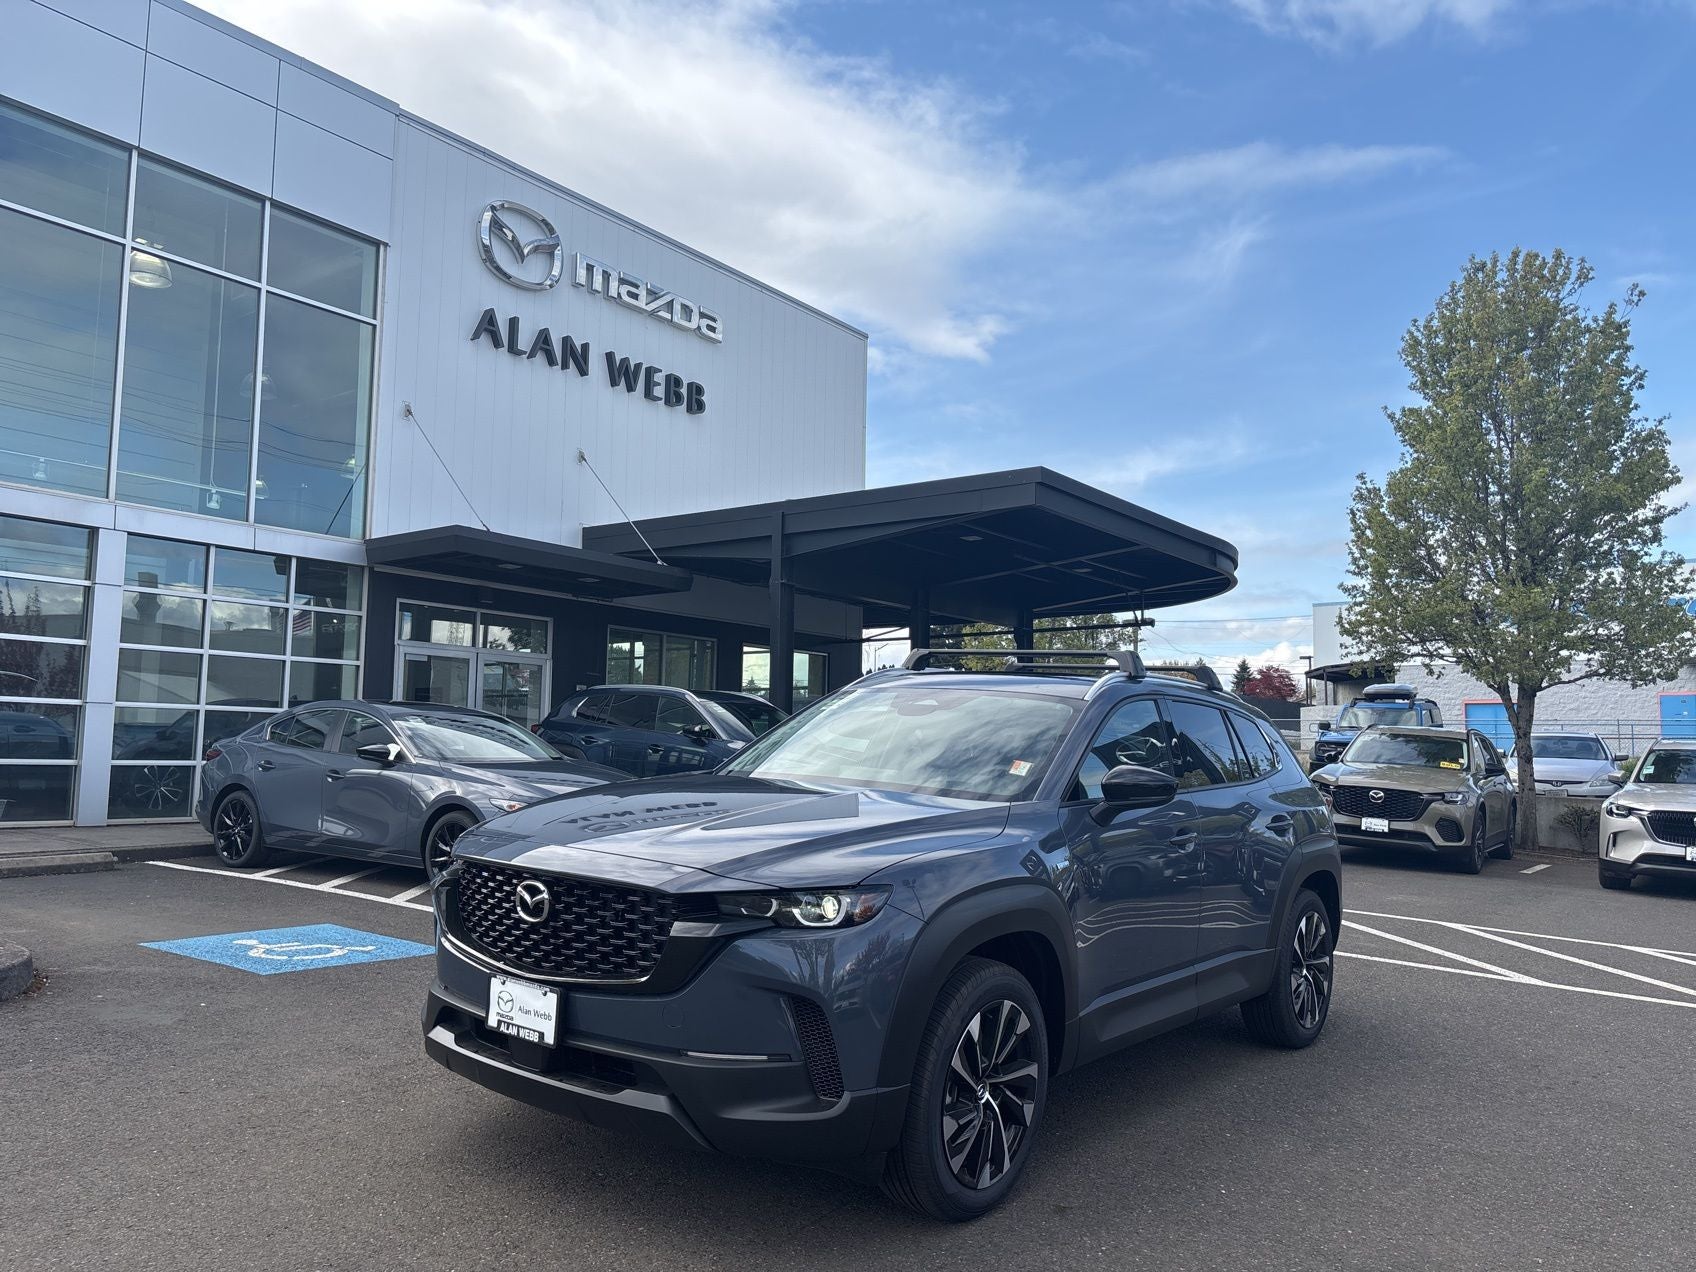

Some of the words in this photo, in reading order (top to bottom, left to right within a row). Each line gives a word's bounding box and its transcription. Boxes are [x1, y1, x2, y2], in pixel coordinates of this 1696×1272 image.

[571, 252, 723, 344] mazda
[470, 307, 590, 377] ALAN
[605, 351, 706, 415] WEBB
[496, 1012, 513, 1021] mazda
[518, 1005, 531, 1016] Alan
[533, 1009, 552, 1021] Webb
[500, 1021, 518, 1036] ALAN
[519, 1027, 540, 1042] WEBB
